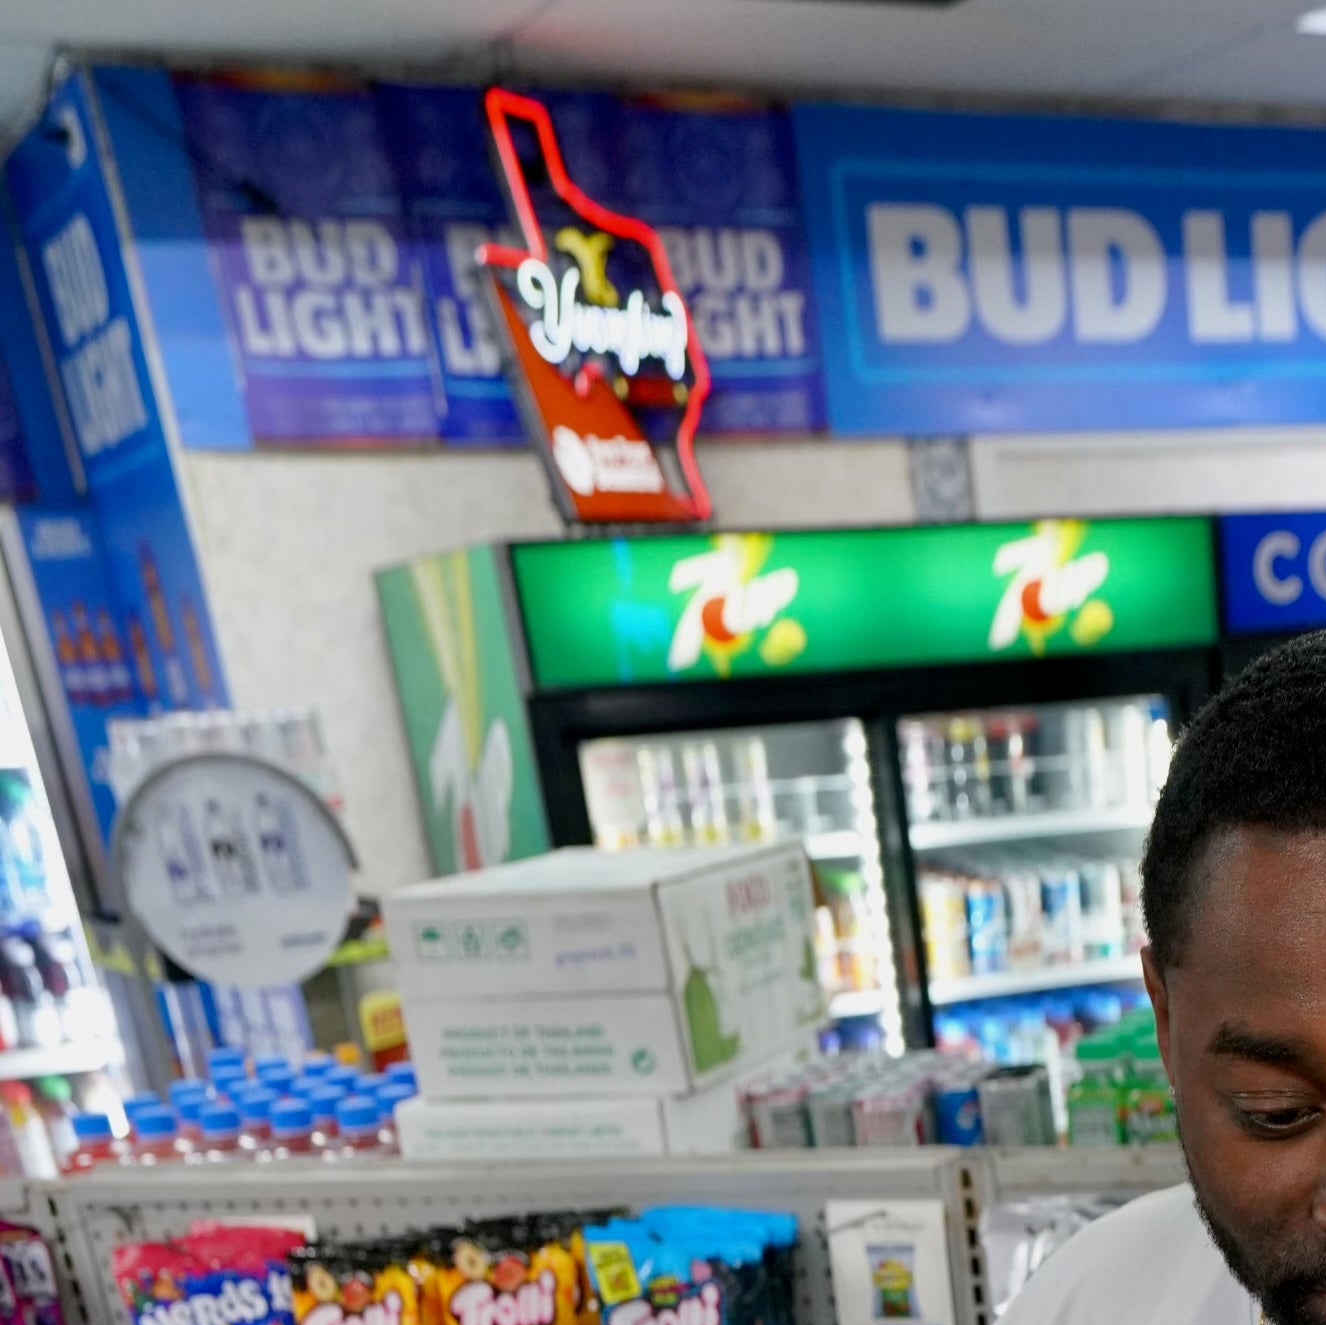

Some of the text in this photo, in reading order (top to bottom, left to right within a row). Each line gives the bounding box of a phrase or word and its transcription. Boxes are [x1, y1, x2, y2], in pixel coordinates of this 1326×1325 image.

[239, 216, 394, 286] BUD
[865, 201, 1168, 346] BUD
[237, 288, 428, 358] LIGHT
